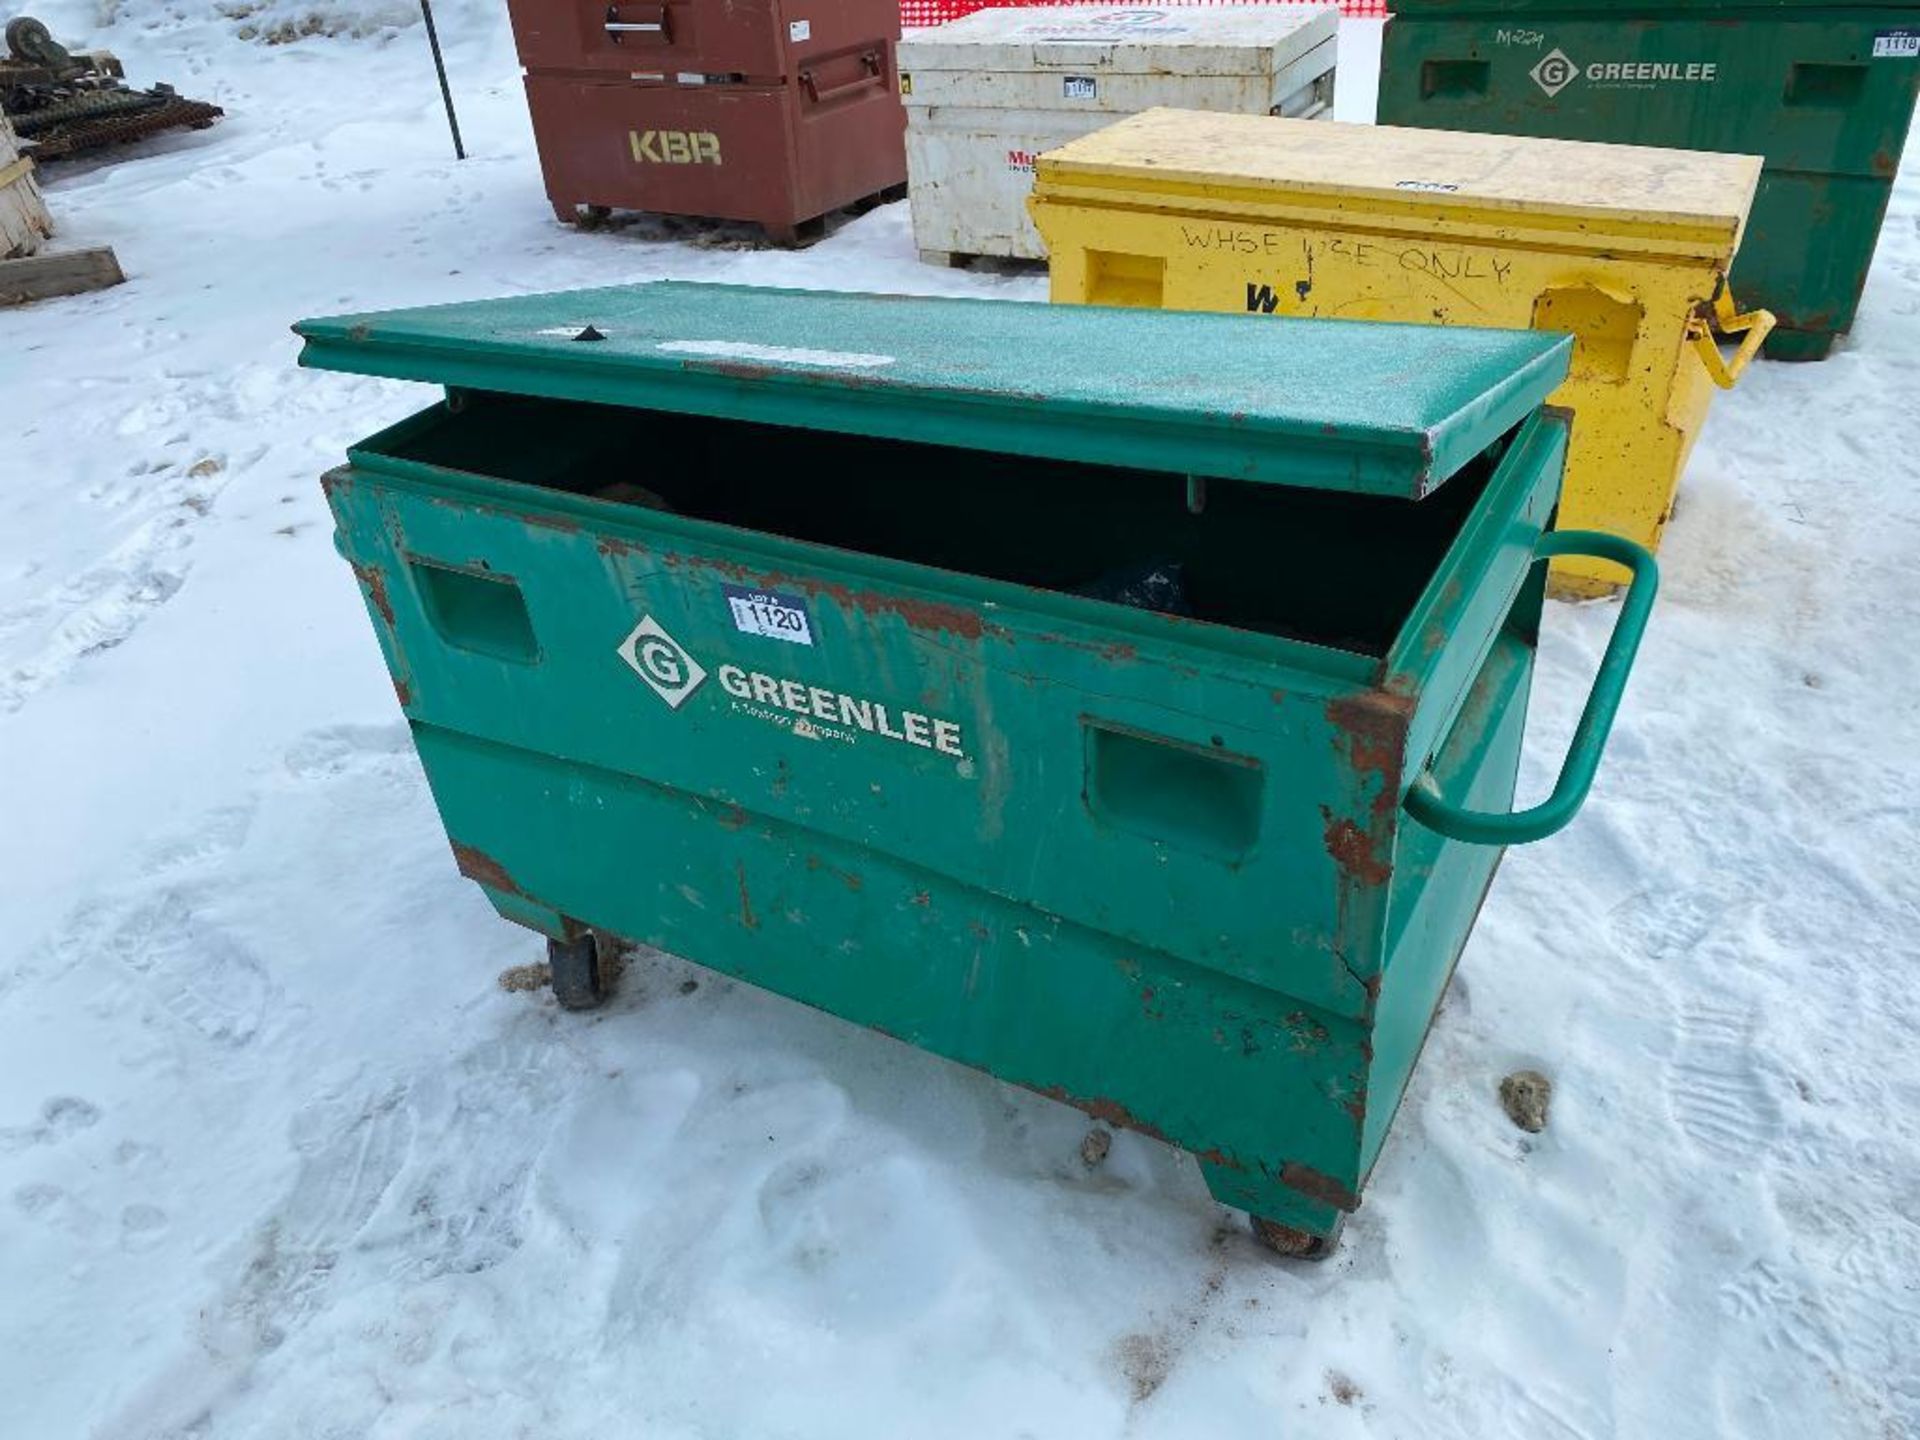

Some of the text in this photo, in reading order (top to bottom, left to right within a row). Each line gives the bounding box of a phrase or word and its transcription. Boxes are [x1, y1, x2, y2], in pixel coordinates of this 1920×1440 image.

[1586, 62, 1718, 81] GREENLEE
[629, 129, 722, 166] KBR
[1008, 150, 1038, 166] Mu
[1181, 226, 1280, 256] WHSE
[1400, 249, 1512, 285] ONLY
[748, 604, 803, 632] 1120
[643, 641, 681, 684] G
[718, 664, 964, 757] GREENLEE
